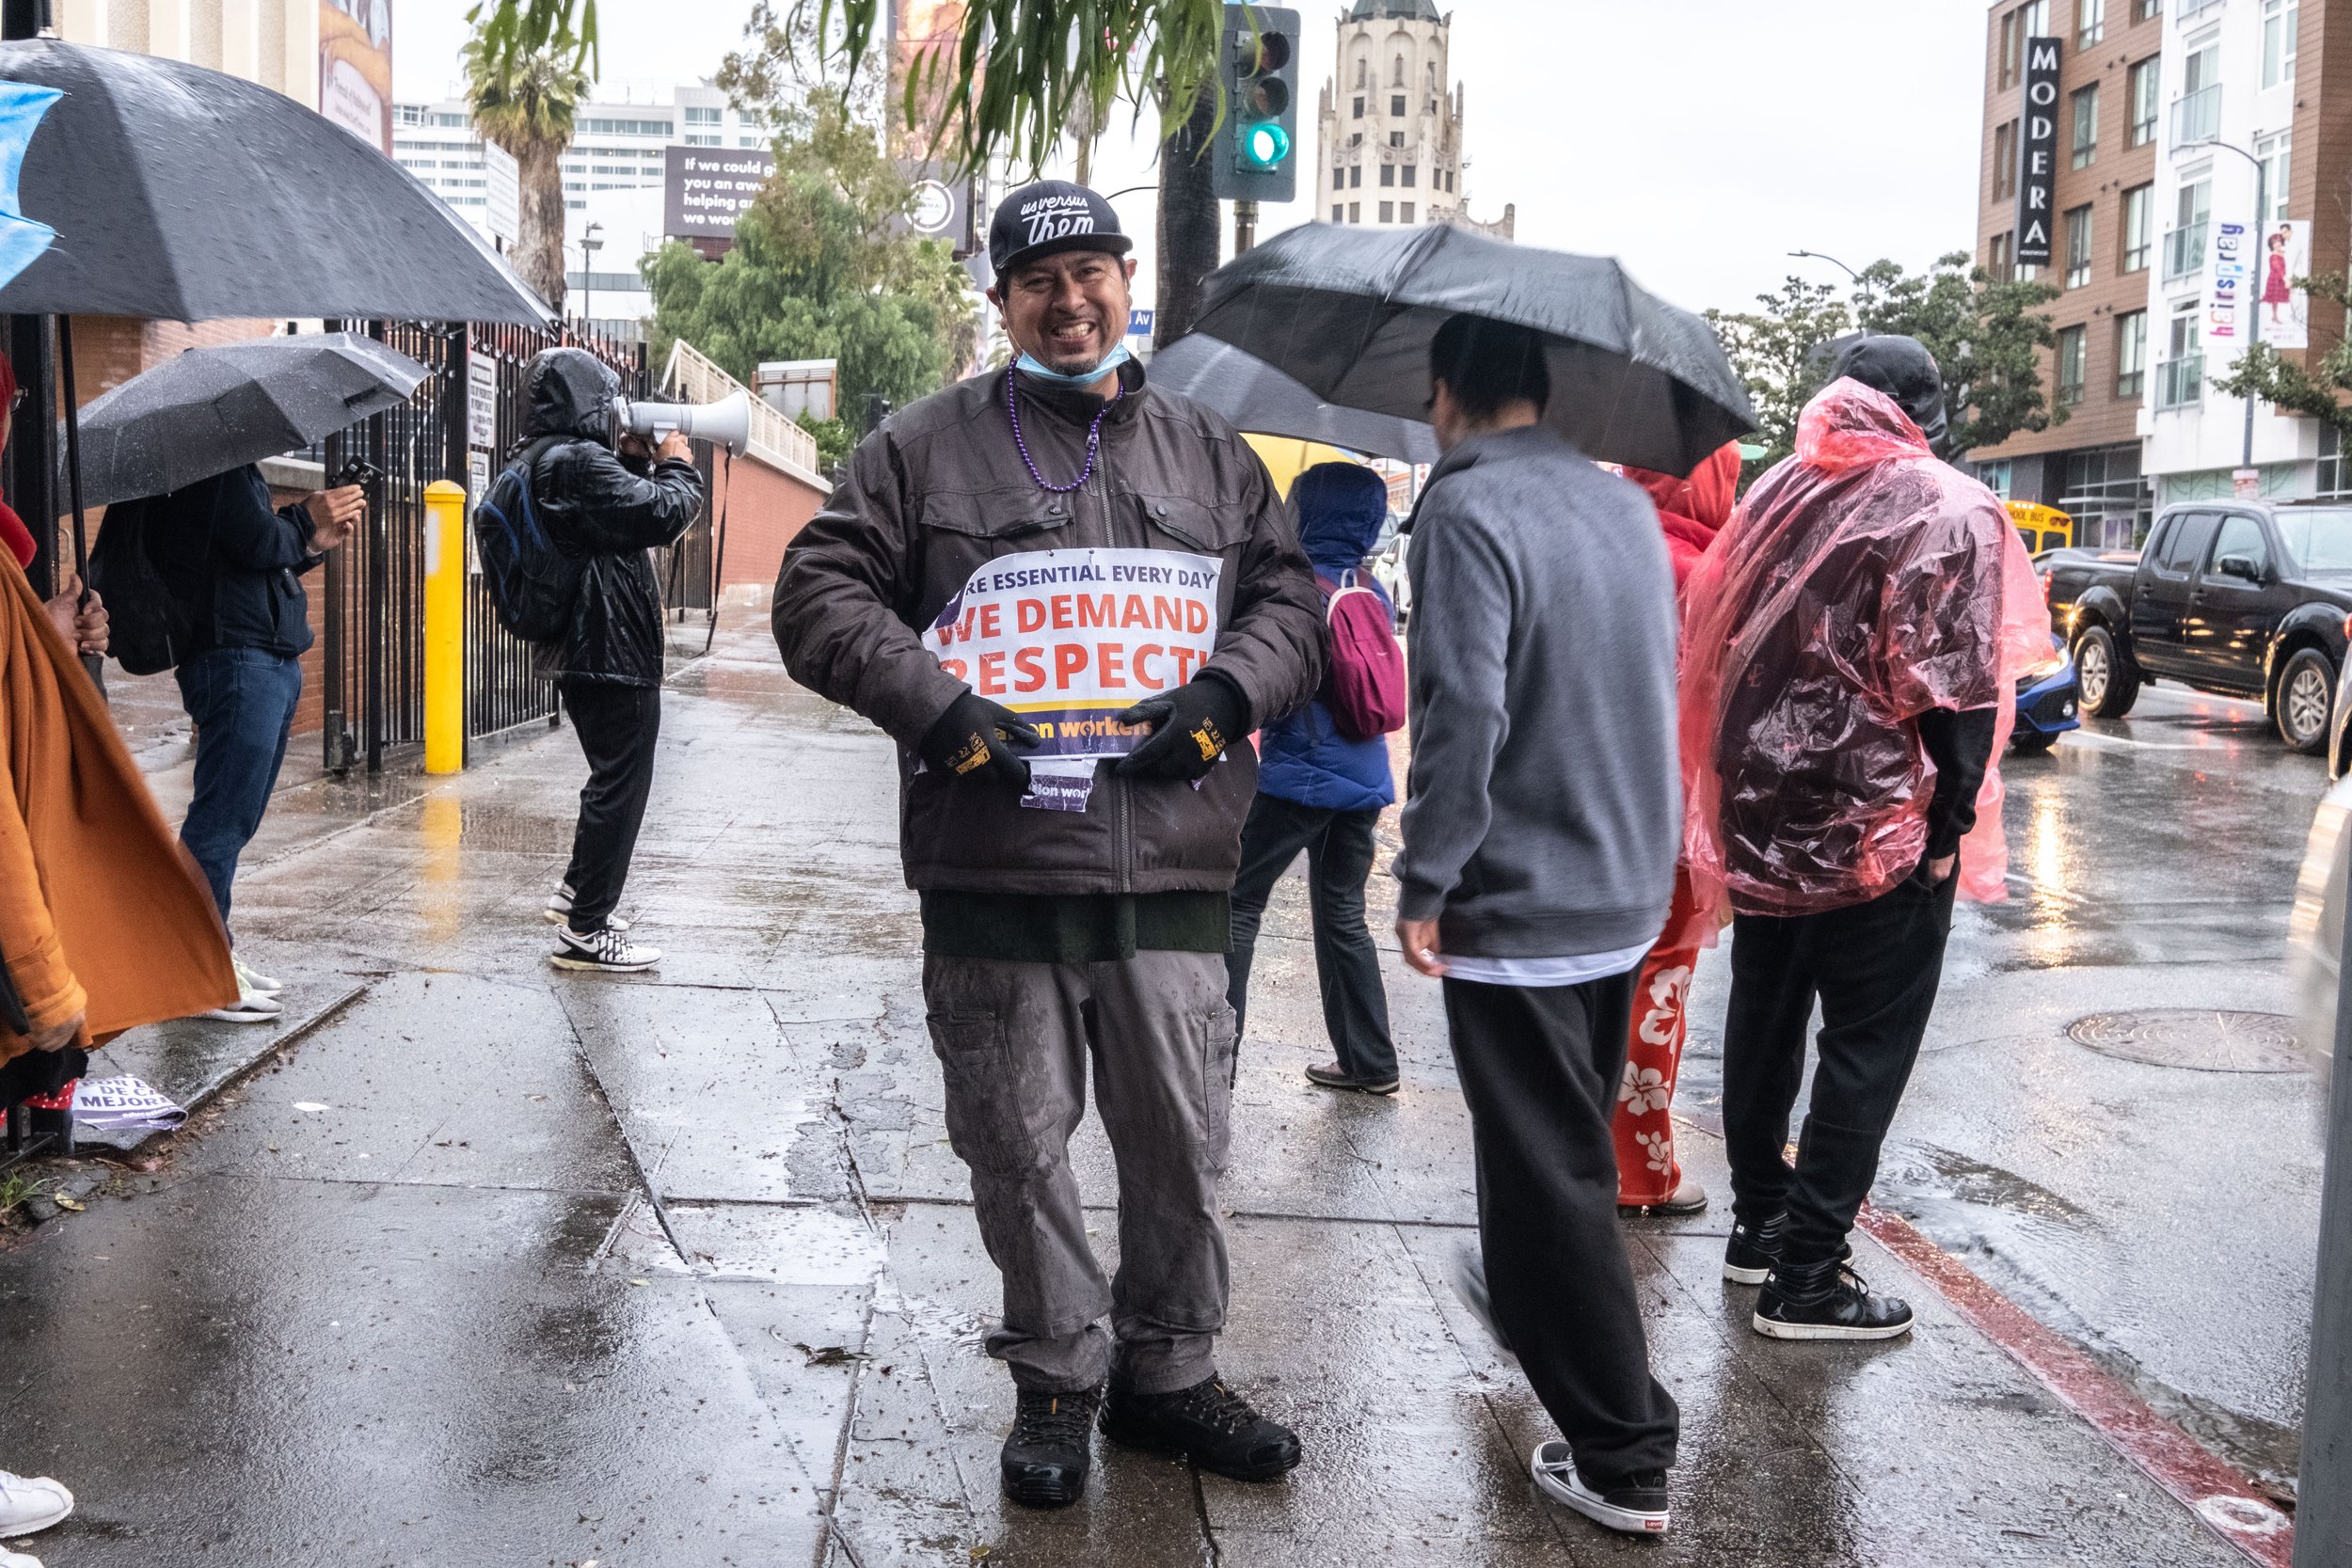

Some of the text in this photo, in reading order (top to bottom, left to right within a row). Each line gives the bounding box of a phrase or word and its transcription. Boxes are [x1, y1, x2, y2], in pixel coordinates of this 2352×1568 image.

[2025, 45, 2058, 245] MODERA
[684, 157, 777, 178] If we could gi
[684, 179, 711, 192] you
[713, 180, 733, 190] an
[683, 193, 737, 212] helping
[683, 214, 706, 225] we
[2209, 223, 2245, 338] hairspray
[1135, 311, 1150, 325] Av
[2029, 511, 2045, 523] BUS
[964, 564, 1216, 596] RE ESSENTIAL EVERY DAY
[935, 594, 1210, 647] WE DEMAND
[99, 1085, 129, 1096] DE
